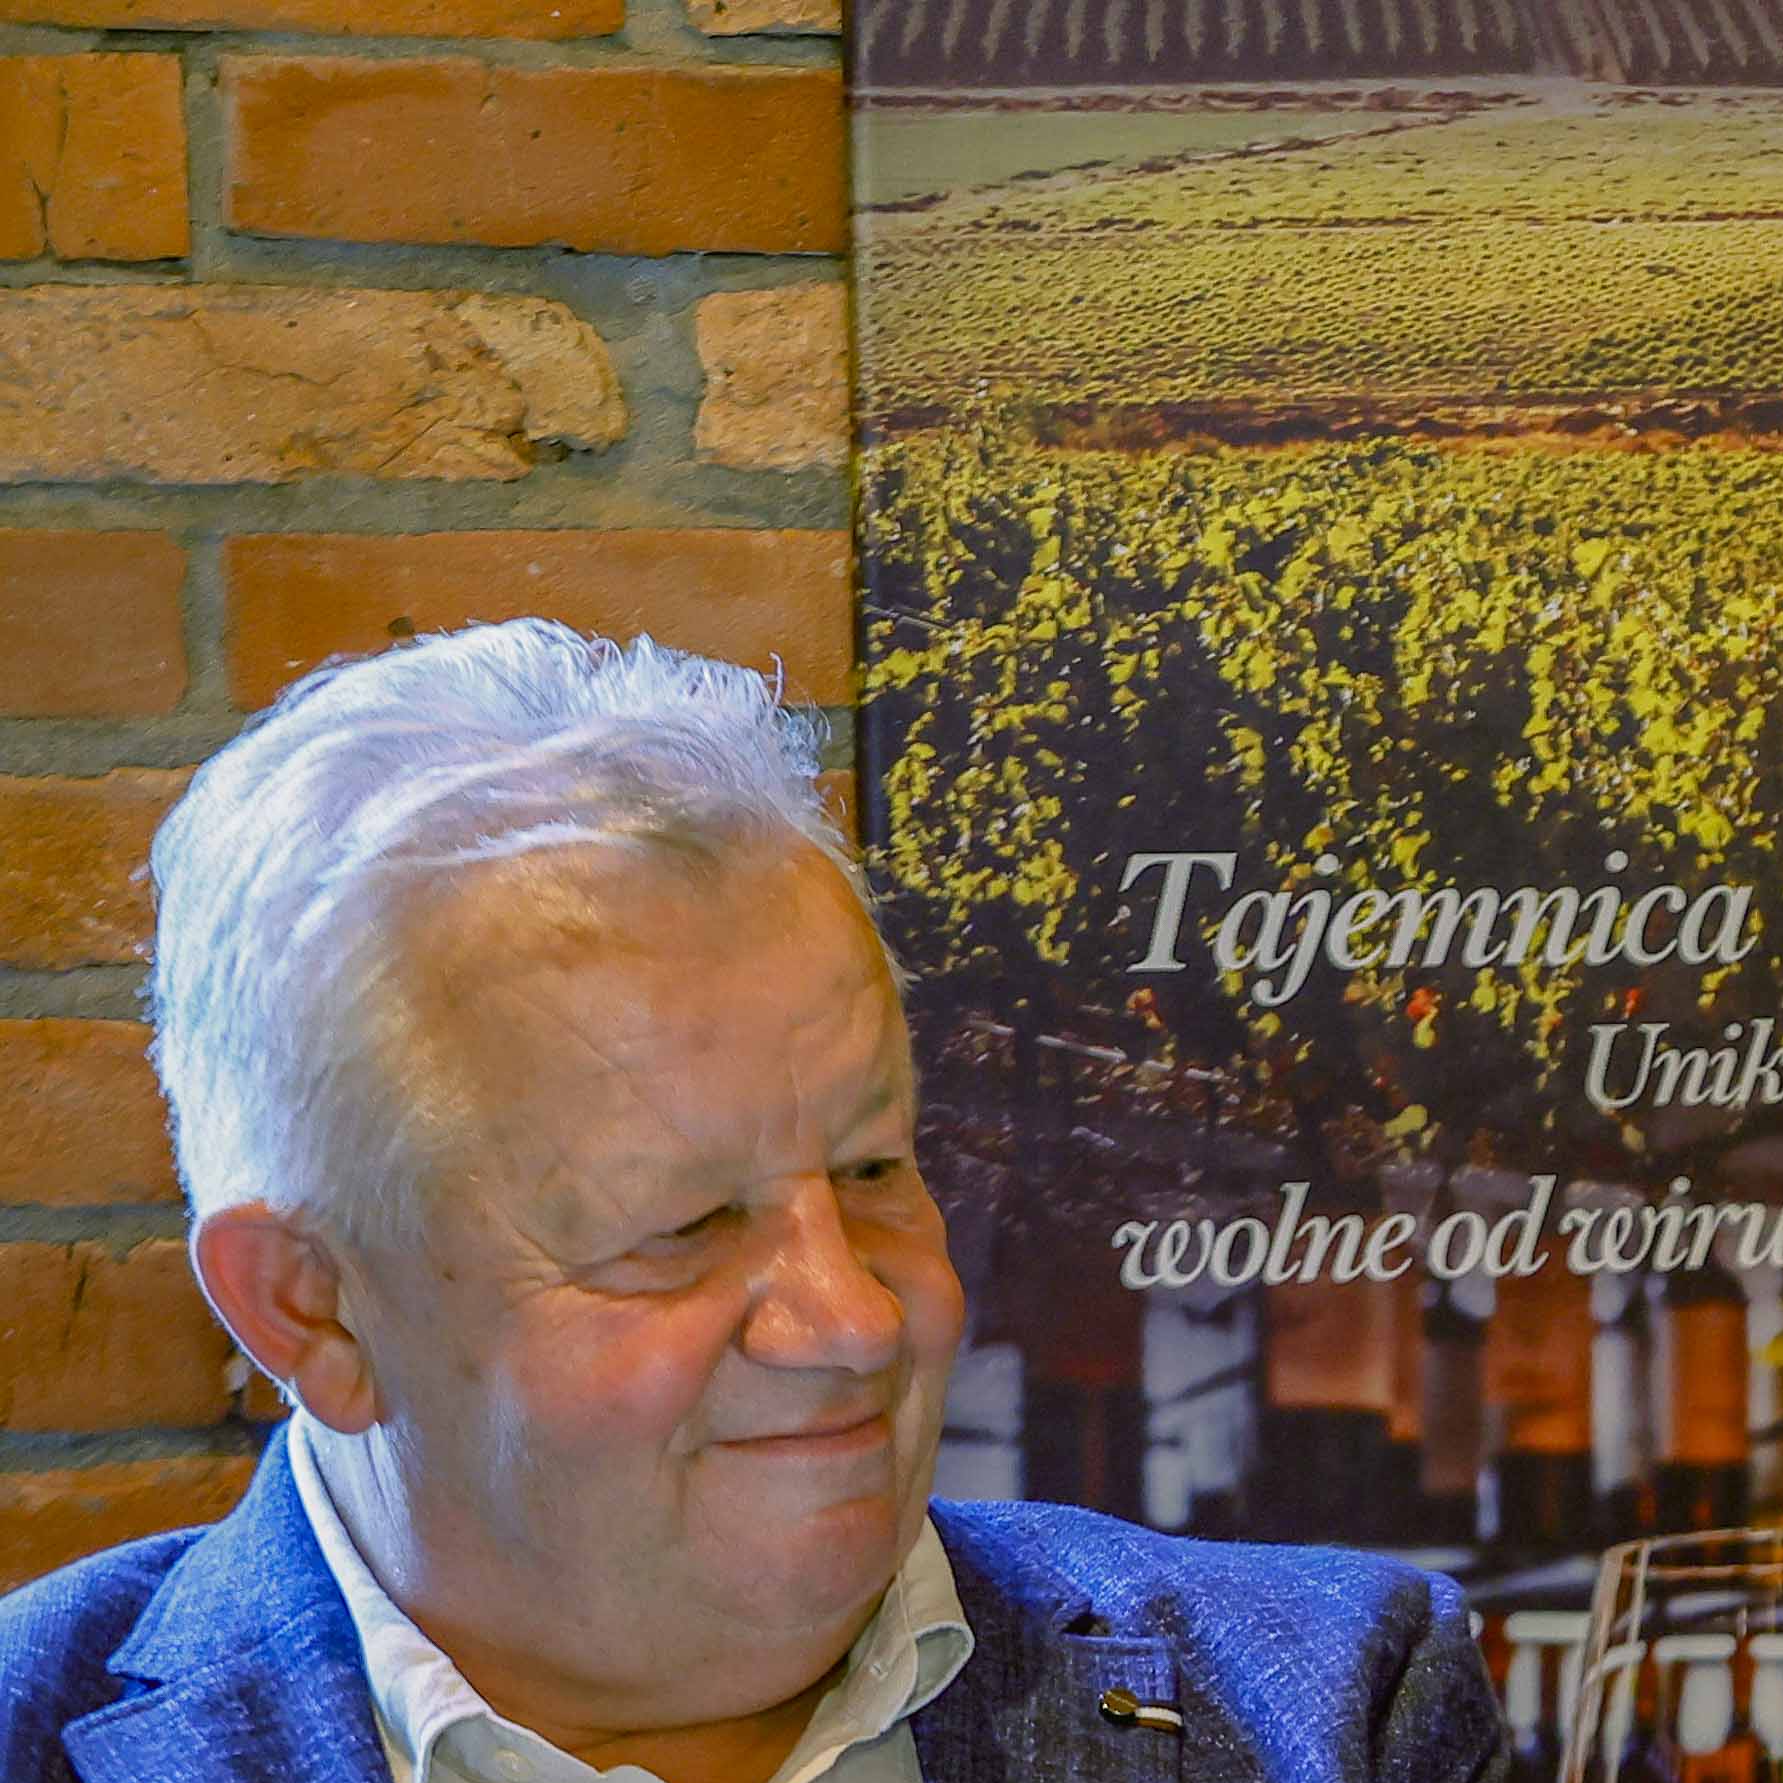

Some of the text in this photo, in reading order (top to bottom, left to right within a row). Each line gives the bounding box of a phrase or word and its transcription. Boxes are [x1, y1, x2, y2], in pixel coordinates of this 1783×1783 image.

[1117, 848, 1761, 1008] Tajemnica
[1111, 1180, 1416, 1291] wolne
[1426, 1173, 1556, 1279] od
